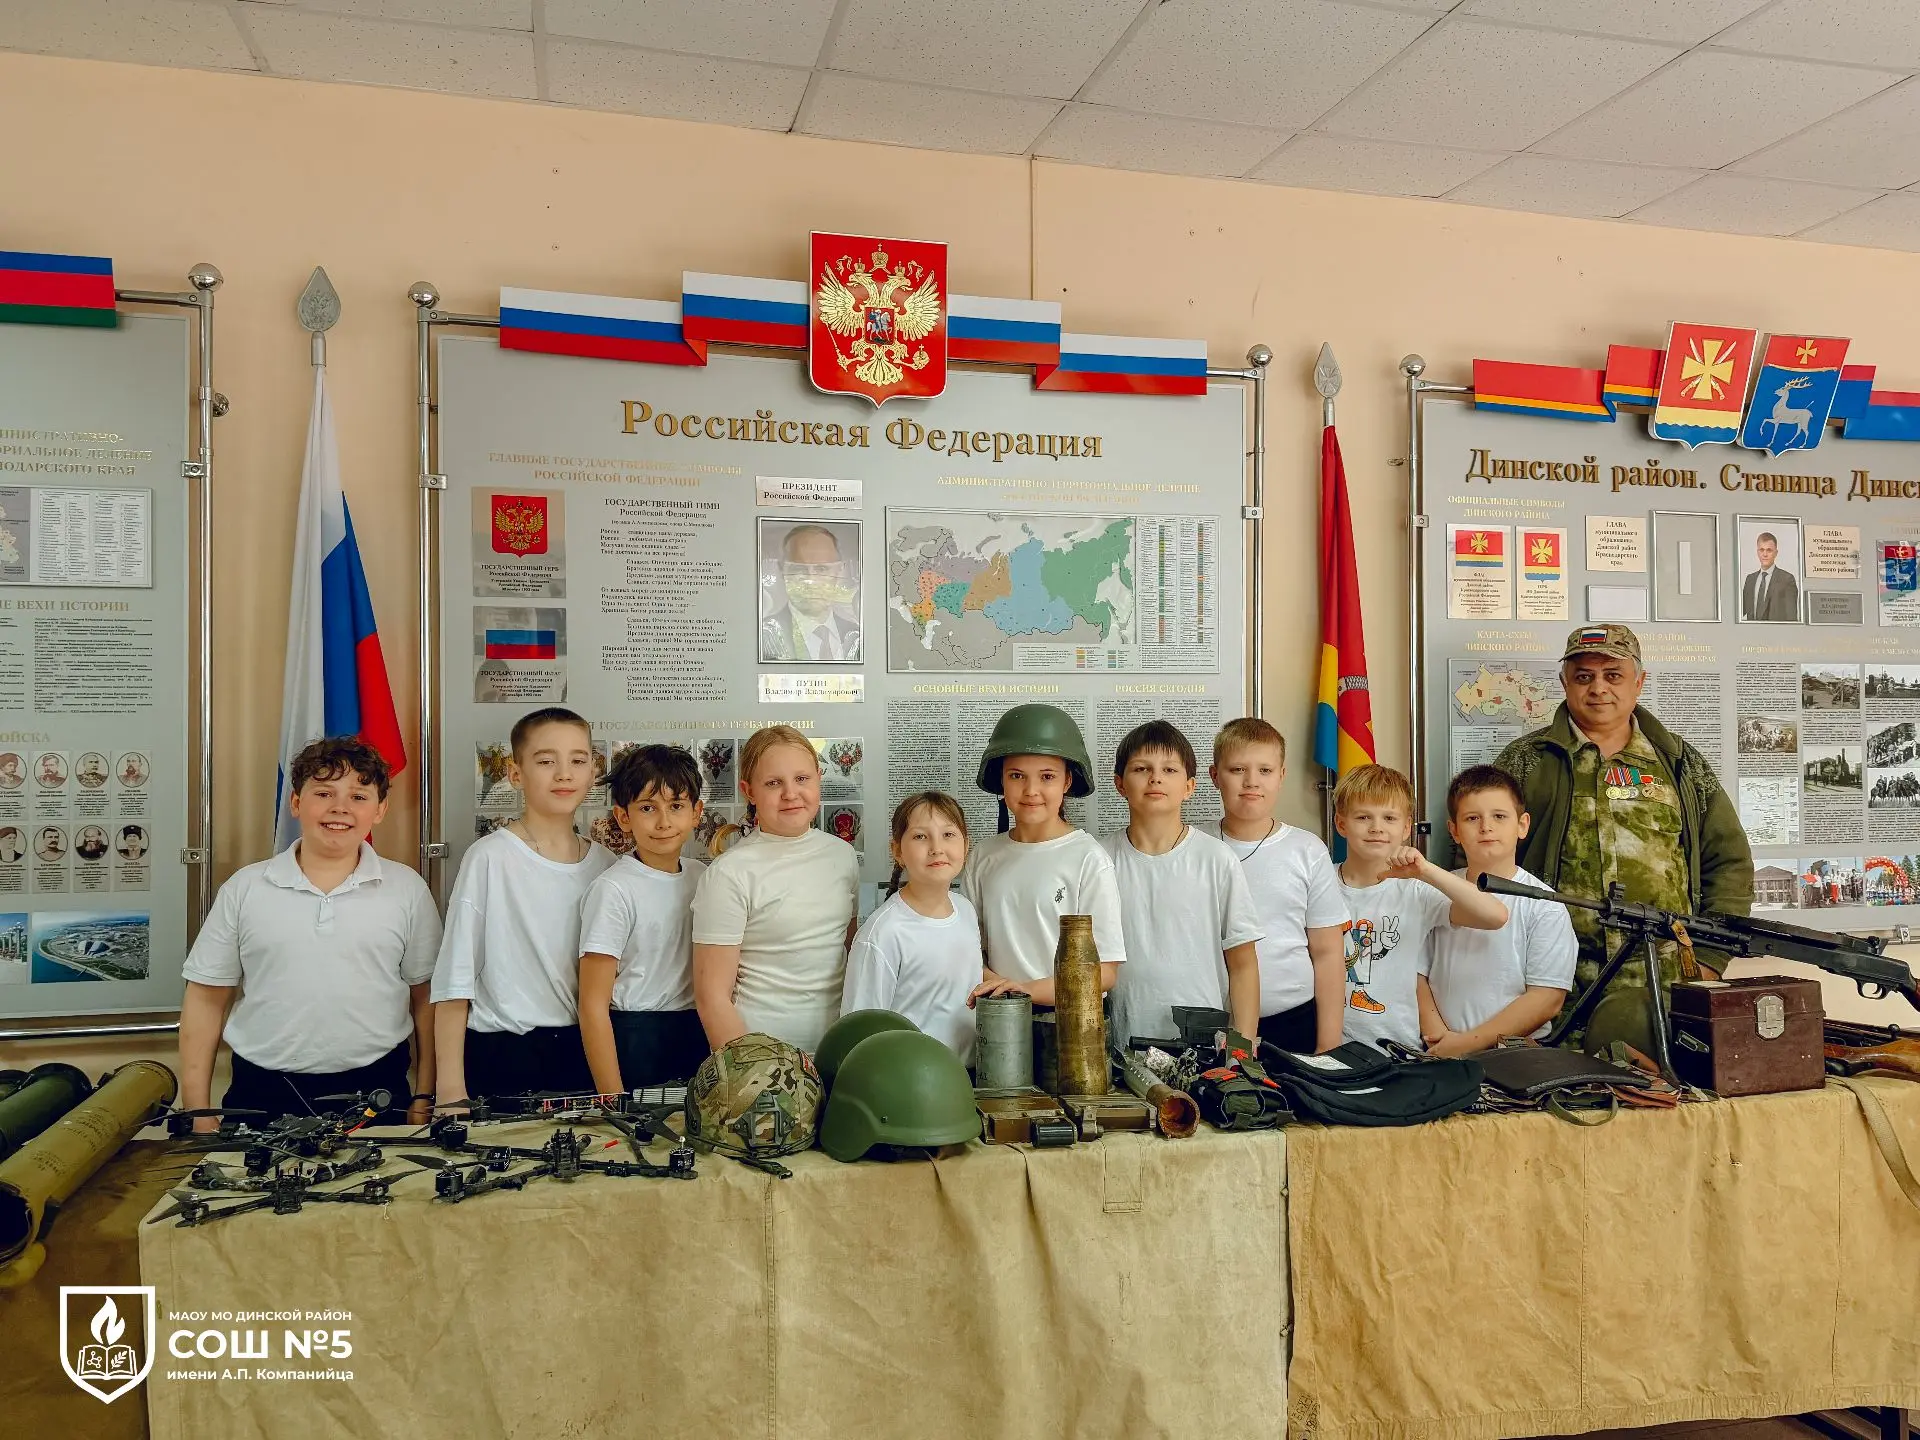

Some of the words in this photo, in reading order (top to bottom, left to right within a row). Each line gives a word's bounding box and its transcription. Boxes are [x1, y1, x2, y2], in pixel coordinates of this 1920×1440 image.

[621, 399, 869, 448] Российская
[885, 416, 1102, 462] Федерация
[0, 446, 82, 458] РИАЛЬНОЕ
[489, 452, 550, 465] ГЛАВНЫЕ
[98, 465, 135, 475] КРАЯ
[1465, 448, 1600, 484] Динской
[1611, 459, 1707, 492] район.
[1720, 463, 1837, 499] Станица
[1848, 470, 1920, 502] Динс
[534, 470, 621, 483] РОССИЙСКОЙ
[625, 475, 700, 487] ФЕДЕРАЦИИ
[782, 483, 837, 492] ПРЕЗИДЕНТ
[764, 492, 809, 500] Российской
[812, 494, 855, 502] Федерации
[1448, 496, 1518, 506] ОФИЦИАЛЬНЫЕ
[1521, 499, 1565, 508] СИМВОЛЫ
[605, 498, 693, 509] ГОСУДАРСТВЕННЫЙ
[696, 501, 720, 510] ГИМН
[620, 508, 663, 517] Российской
[1464, 509, 1512, 518] ДИНСКОГО
[0, 600, 12, 610] Е
[17, 601, 54, 610] ВЕХИ
[60, 602, 129, 611] ИСТОРИИ
[913, 684, 976, 694] ОСНОВНЫЕ
[978, 684, 1007, 694] ВЕХИ
[1010, 684, 1060, 694] ИСТОРИИ
[1115, 684, 1156, 694] РОССИЯ
[1158, 684, 1206, 694] СЕГОДНЯ
